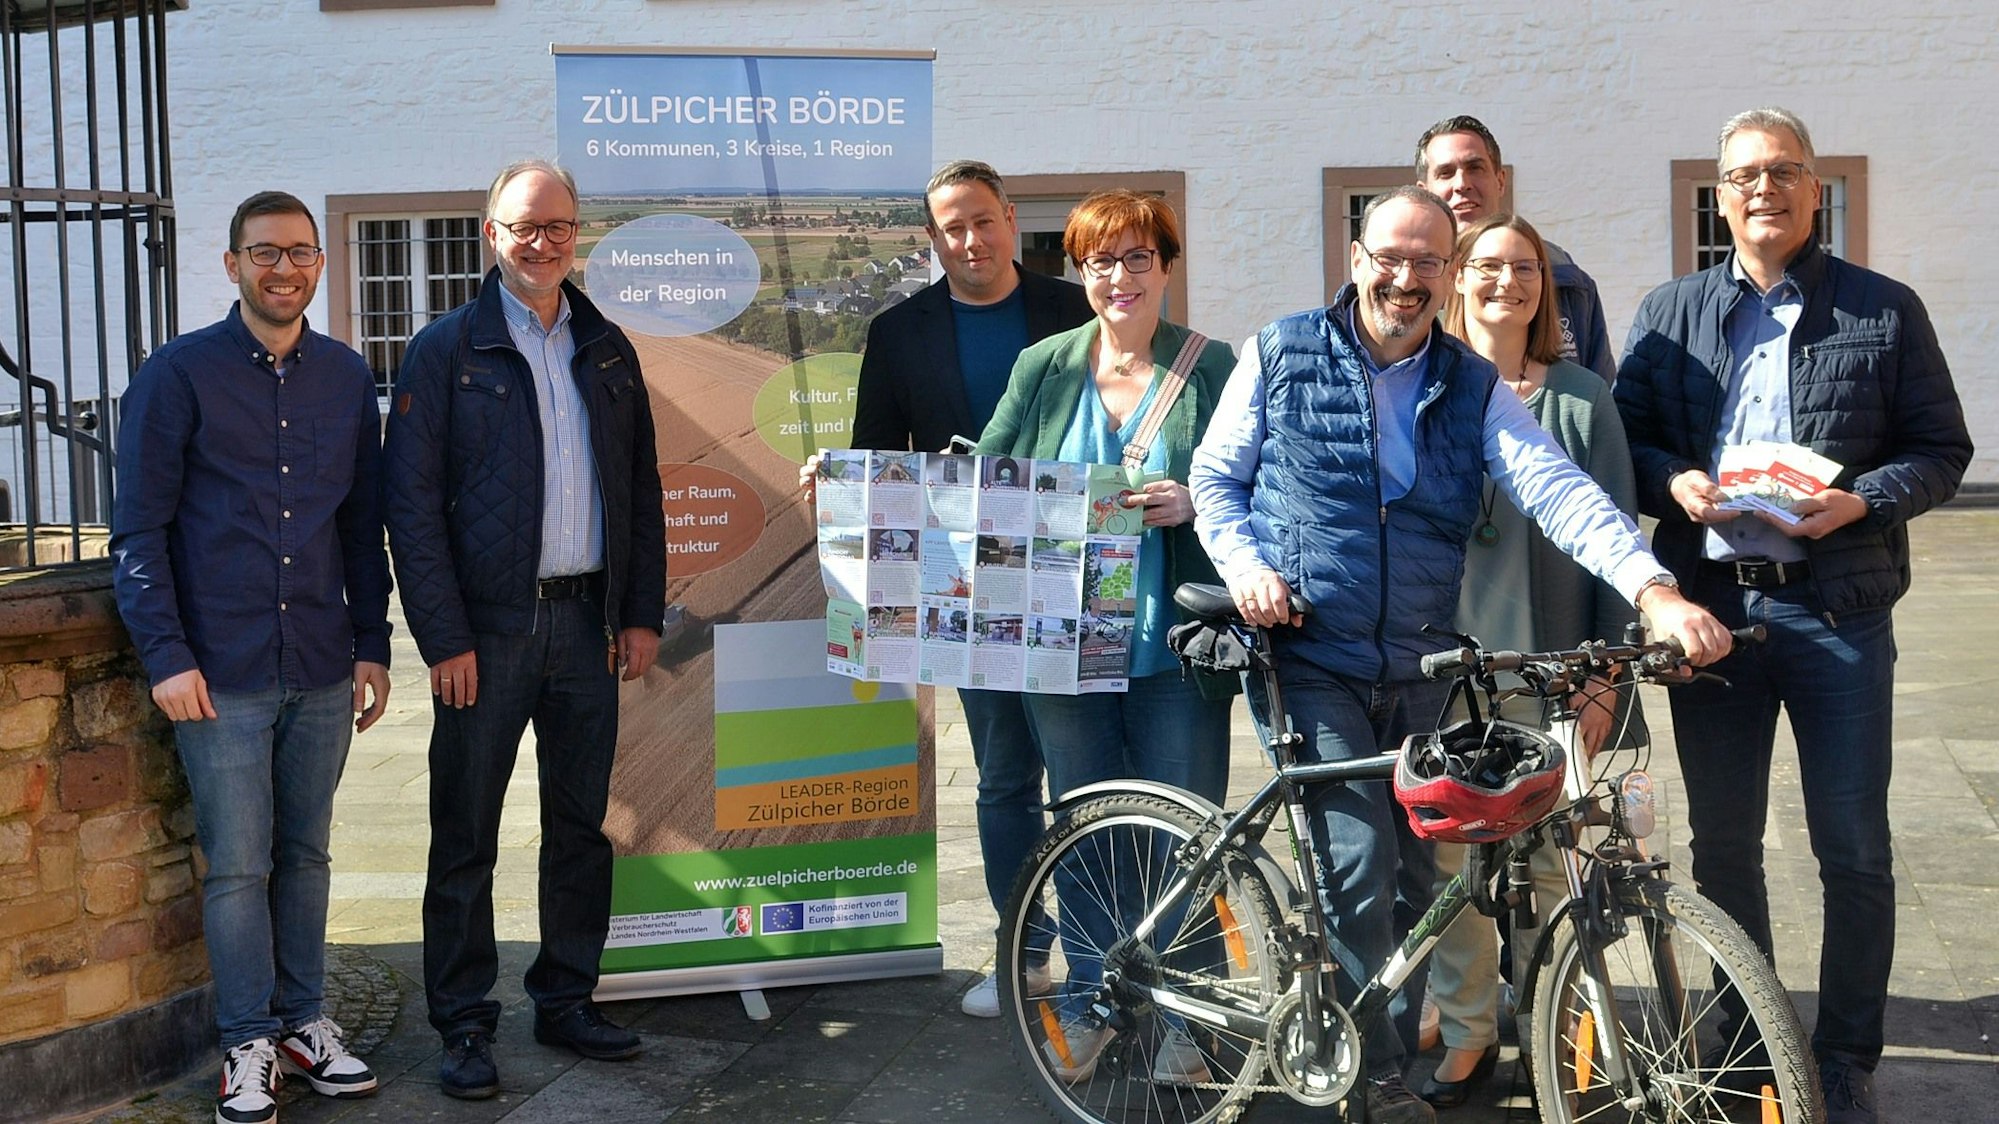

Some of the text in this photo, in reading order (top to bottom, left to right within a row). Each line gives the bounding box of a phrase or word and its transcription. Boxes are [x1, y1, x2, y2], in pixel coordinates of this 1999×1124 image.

[582, 88, 905, 125] ZÜLPICHER BÖRDE
[586, 139, 893, 160] 6 Kommunen, 3 Kreise, 1 Region
[611, 247, 733, 267] Menschen in
[619, 283, 726, 305] der Region
[789, 388, 842, 404] Kultur,
[779, 420, 809, 435] zeit
[814, 418, 844, 433] und
[688, 485, 736, 500] Raum,
[700, 511, 728, 526] und
[780, 778, 909, 799] LEADER-Region
[747, 794, 910, 824] Zülpicher Börde
[1036, 835, 1059, 863] ACE
[1069, 809, 1105, 830] PACE
[693, 860, 918, 892] www.zuelpicherboerde.de
[808, 902, 863, 913] Kofinanziert
[884, 898, 899, 906] der
[651, 910, 702, 920] Landwirtschaft
[808, 910, 899, 924] Europäischen Union
[611, 921, 678, 931] Verbraucherschutz
[611, 932, 636, 940] Landes
[637, 926, 708, 938] Nordrhein-Westfalen
